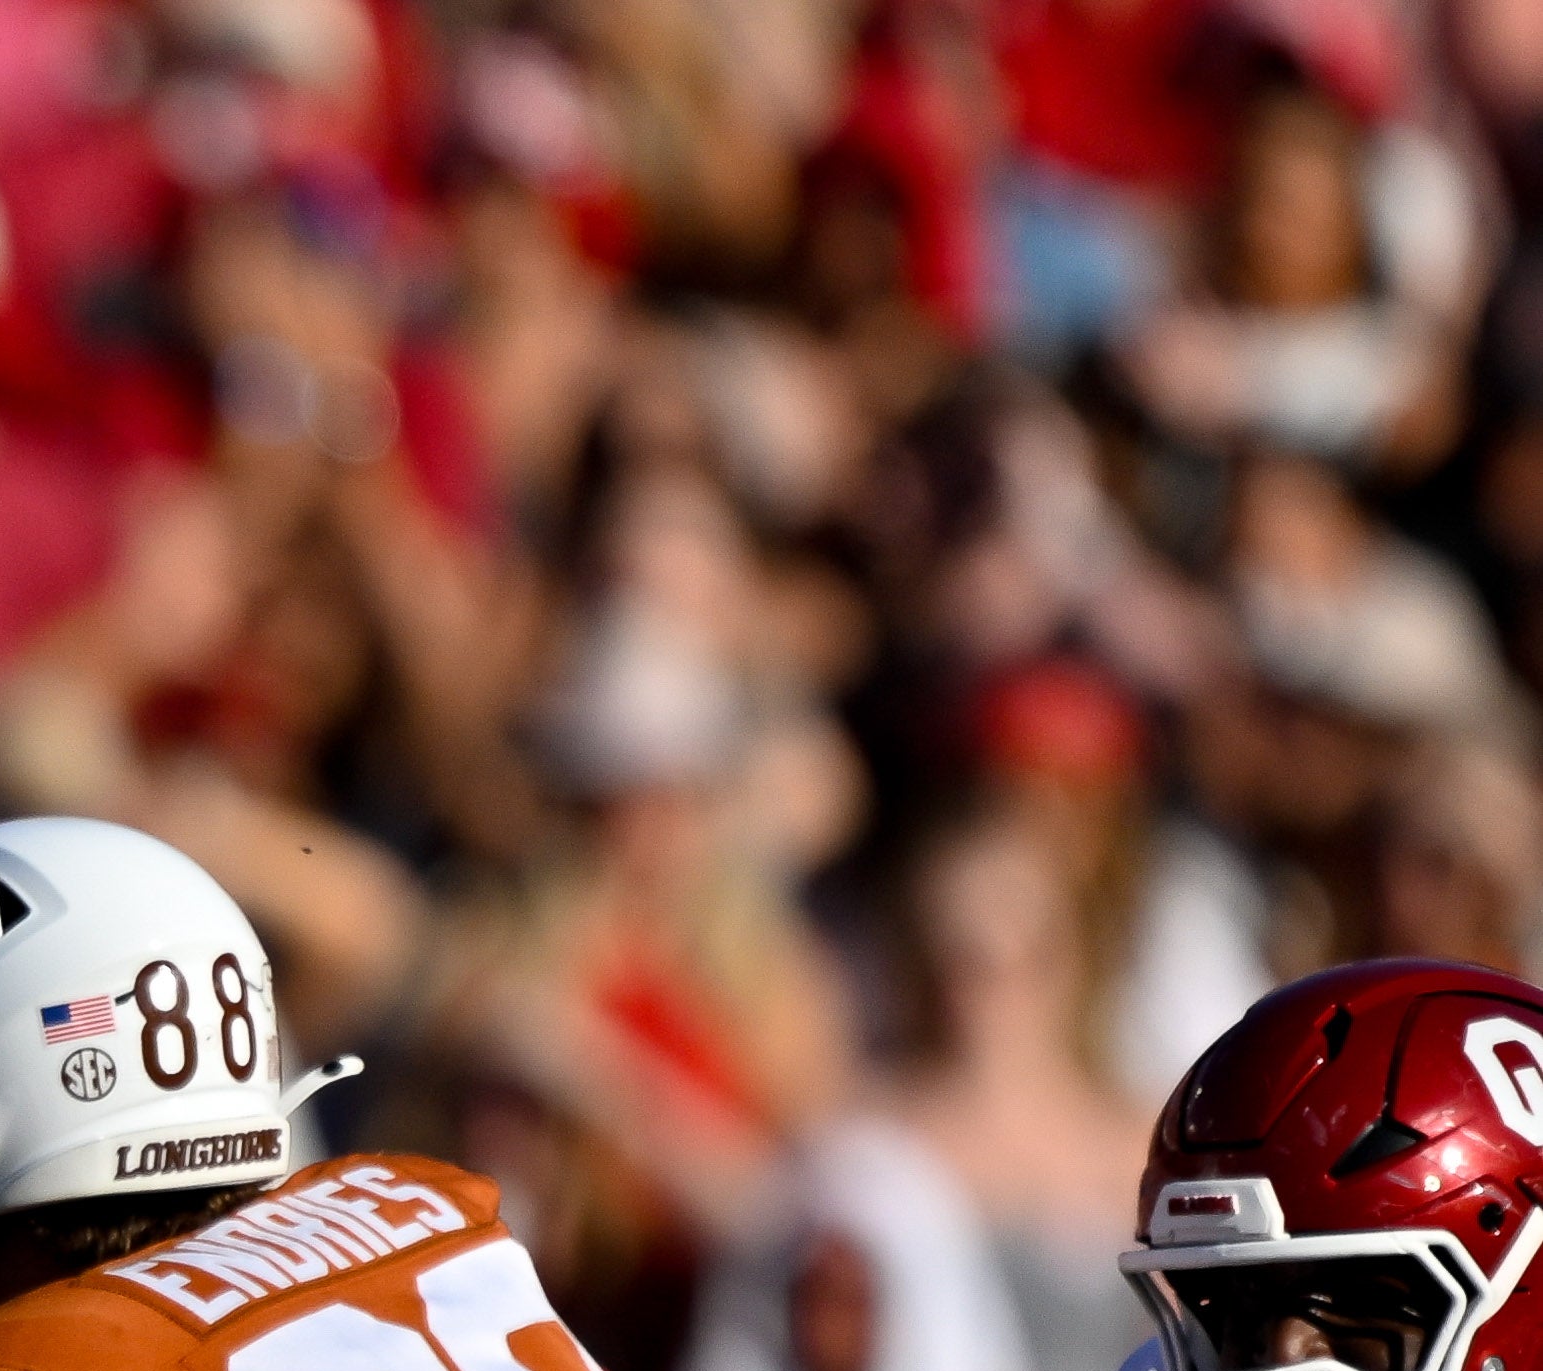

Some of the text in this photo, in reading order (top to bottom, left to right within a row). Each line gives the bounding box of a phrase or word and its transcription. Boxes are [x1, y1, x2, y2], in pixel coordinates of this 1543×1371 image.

[134, 952, 258, 1091] 88
[64, 1050, 115, 1099] SEC
[114, 1128, 283, 1181] LONGHORNS
[103, 1164, 468, 1326] ENDRIES
